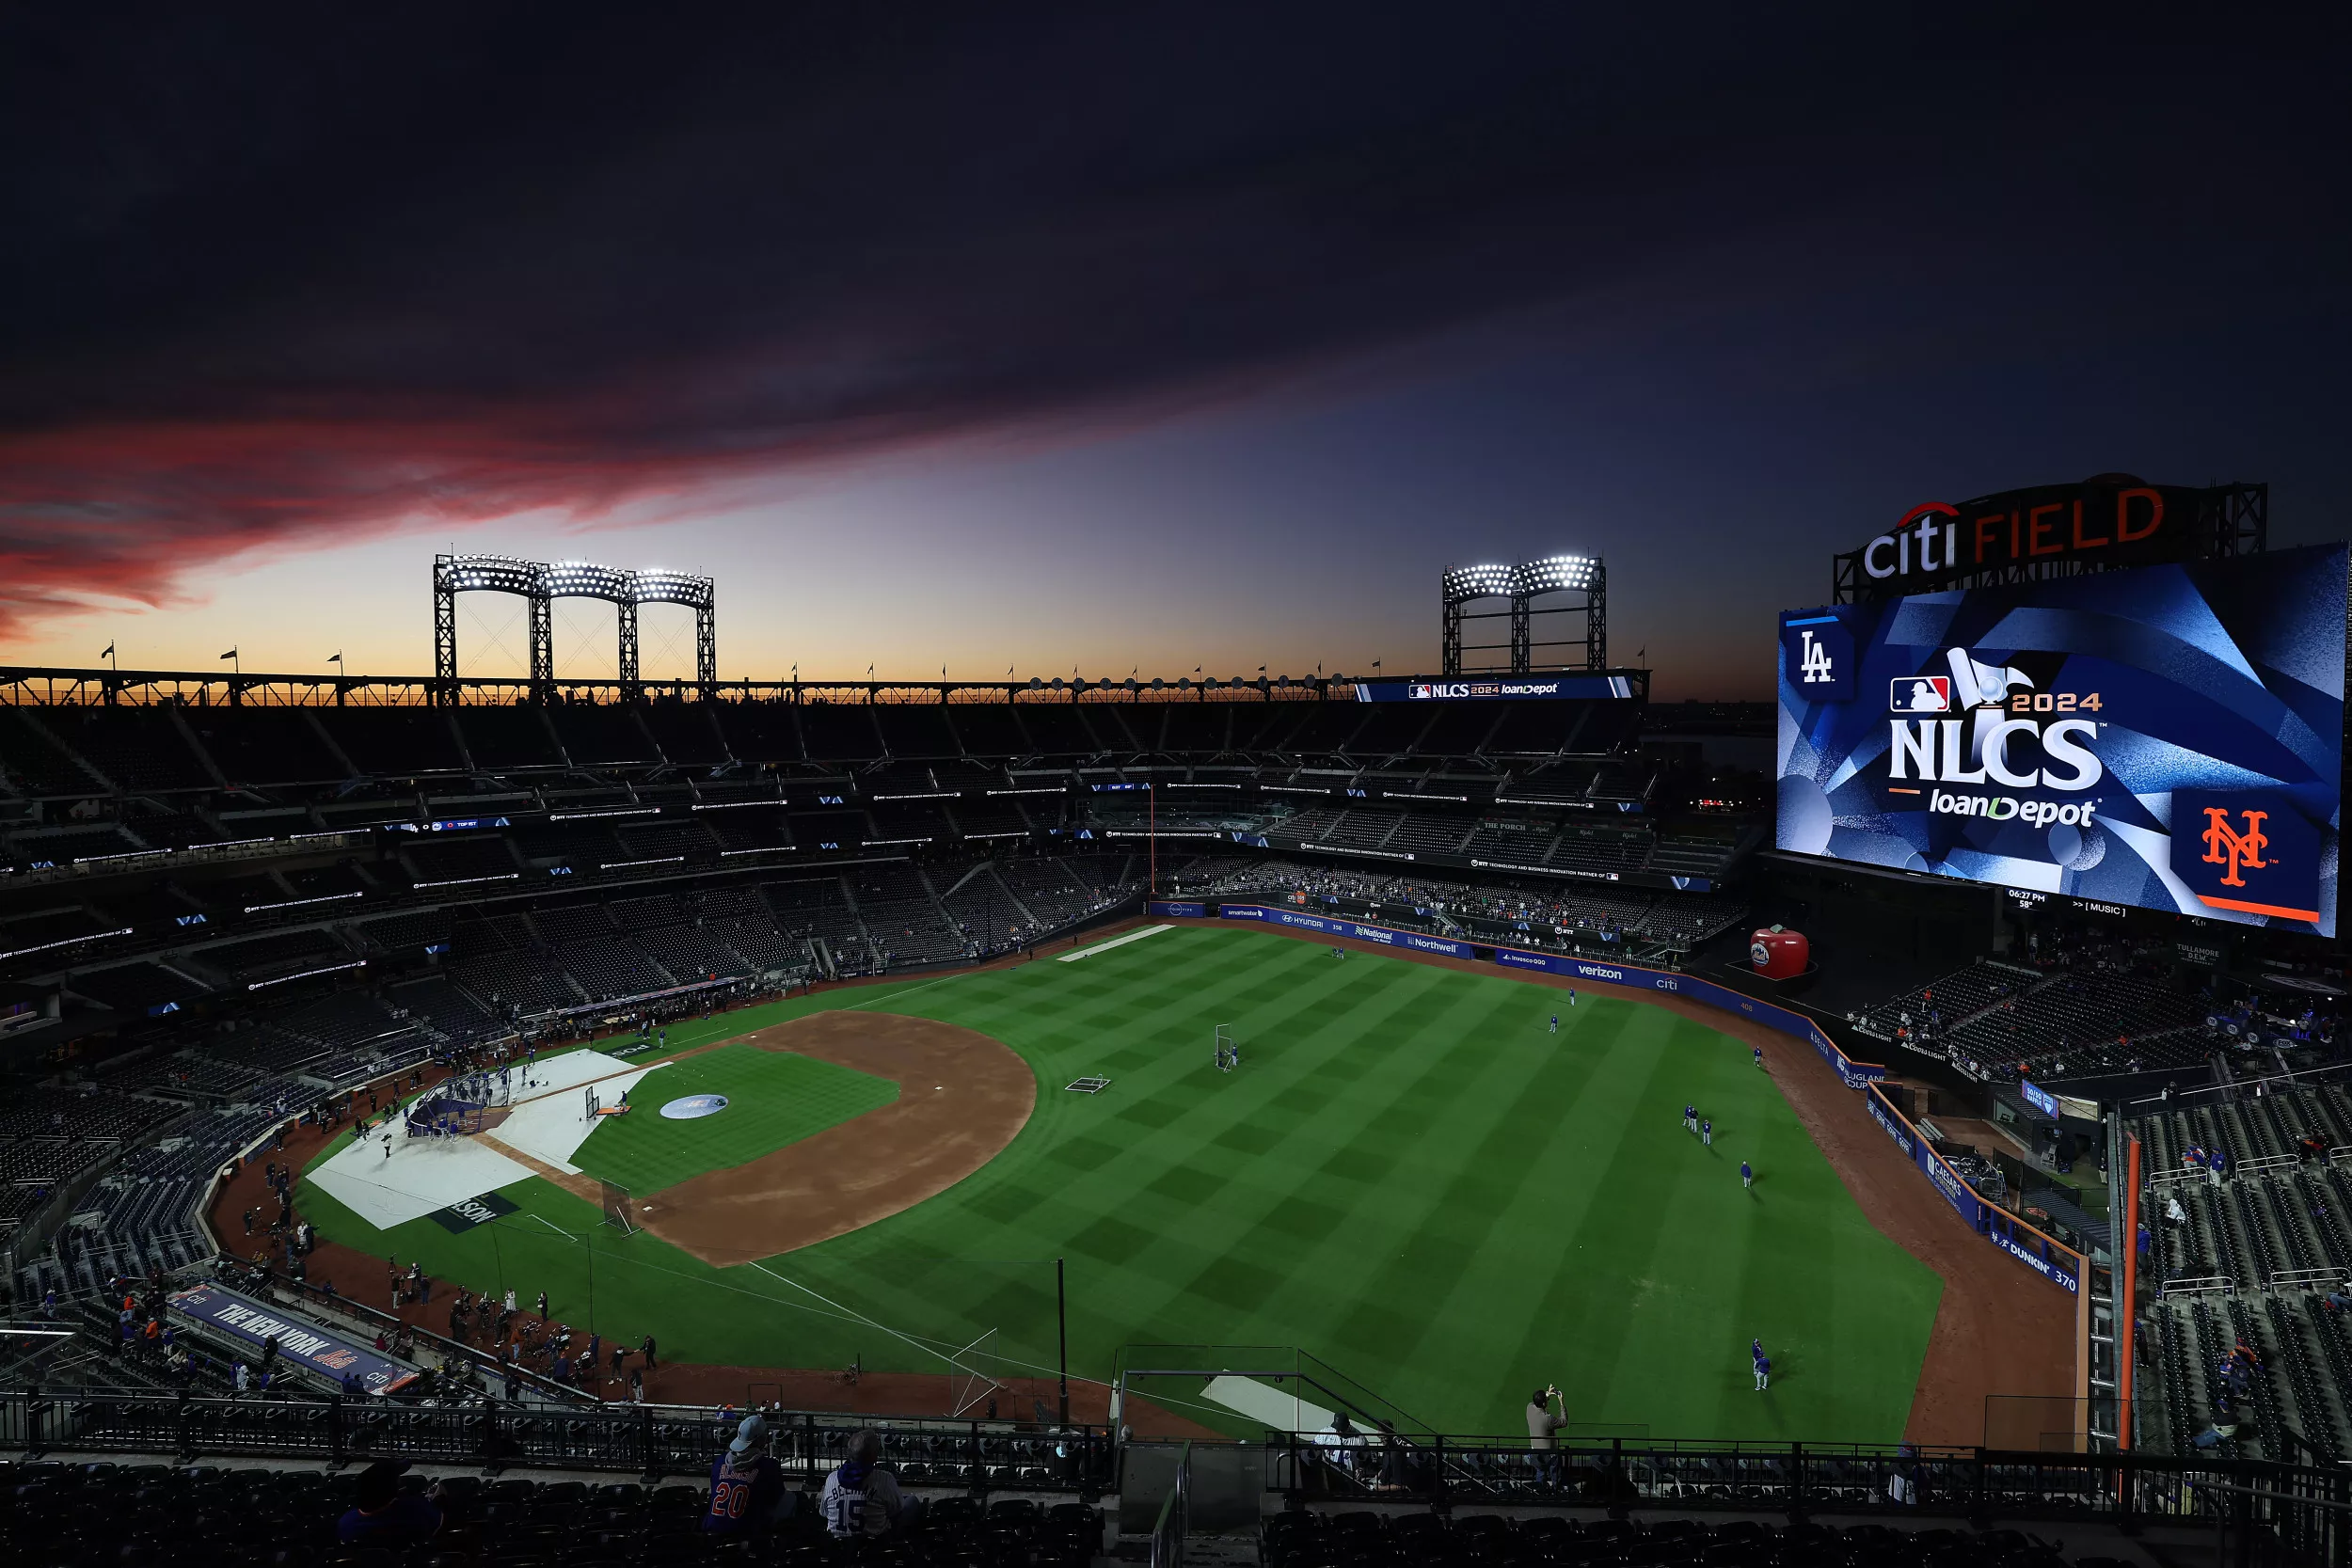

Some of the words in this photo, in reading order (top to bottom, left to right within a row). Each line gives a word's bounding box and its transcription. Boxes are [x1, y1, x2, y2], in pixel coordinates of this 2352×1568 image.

[1864, 515, 1957, 579] citi
[1976, 487, 2164, 563] FIELD
[1801, 630, 1832, 683] LA
[1432, 683, 1470, 698] NLCS
[1470, 686, 1500, 694] 2024
[1501, 683, 1558, 695] loanDepot
[2012, 692, 2103, 712] 2024
[1888, 719, 2103, 791] NLCS
[1930, 788, 2096, 829] loanDepot
[2201, 807, 2268, 887] NY
[2009, 889, 2031, 899] 06:27
[2032, 893, 2045, 902] PM
[2019, 900, 2033, 909] 58°
[2090, 903, 2121, 915] MUSIC
[1294, 916, 1324, 928] HYUNDAI
[1415, 939, 1456, 953] Northwell
[2176, 942, 2219, 958] TULLAMORE
[1512, 956, 1534, 964] Invesco
[1579, 965, 1622, 980] verizon
[1656, 978, 1677, 990] citi
[1815, 1034, 1829, 1056] DELTA
[1876, 1033, 1892, 1043] LIGHT
[1928, 1050, 1946, 1061] LIGHT
[2026, 1086, 2042, 1101] 50/50
[2026, 1094, 2042, 1107] RAFFLE
[1934, 1162, 1962, 1196] CAESARS
[2055, 1270, 2076, 1291] 370
[186, 1294, 208, 1306] citi
[213, 1303, 257, 1324] THE
[238, 1314, 291, 1339] NEW
[277, 1328, 331, 1357] YORK
[366, 1371, 390, 1385] citi
[711, 1481, 750, 1520] 20
[836, 1499, 867, 1533] 15
